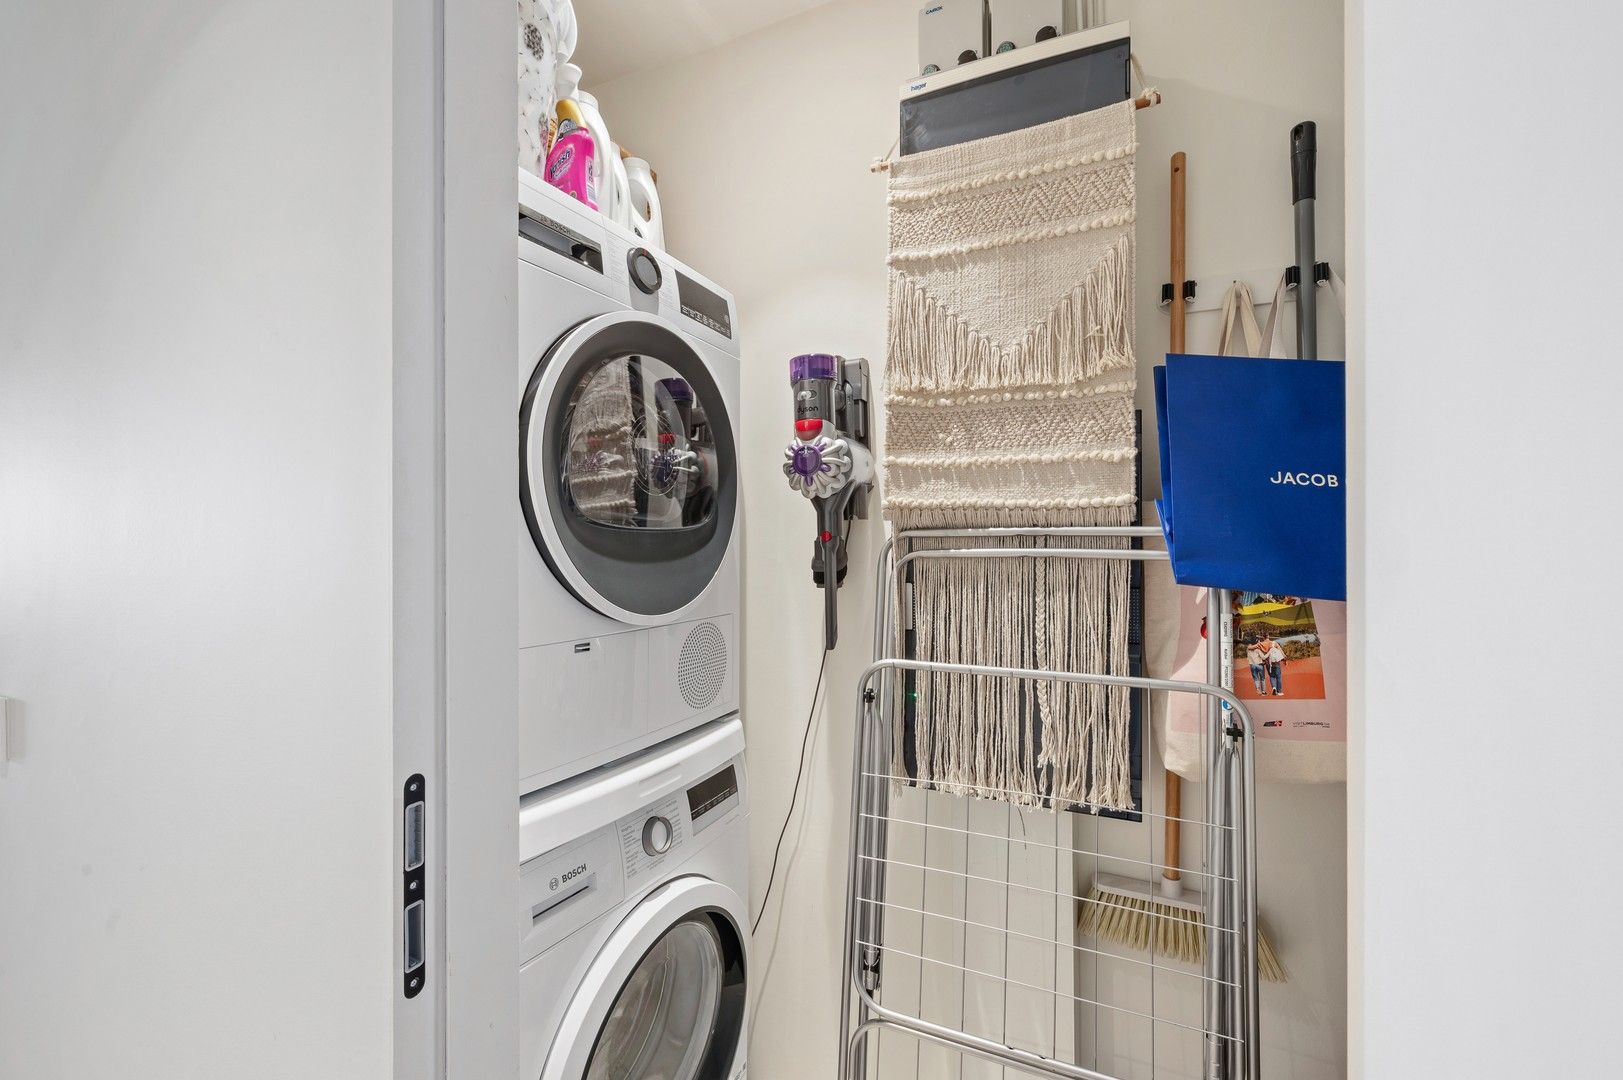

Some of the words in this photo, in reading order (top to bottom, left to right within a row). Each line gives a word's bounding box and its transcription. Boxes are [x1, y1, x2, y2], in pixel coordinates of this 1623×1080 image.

[550, 218, 571, 234] BOSCH
[798, 405, 819, 415] dyson
[1270, 471, 1339, 488] JACOB
[561, 862, 587, 883] BOSCH
